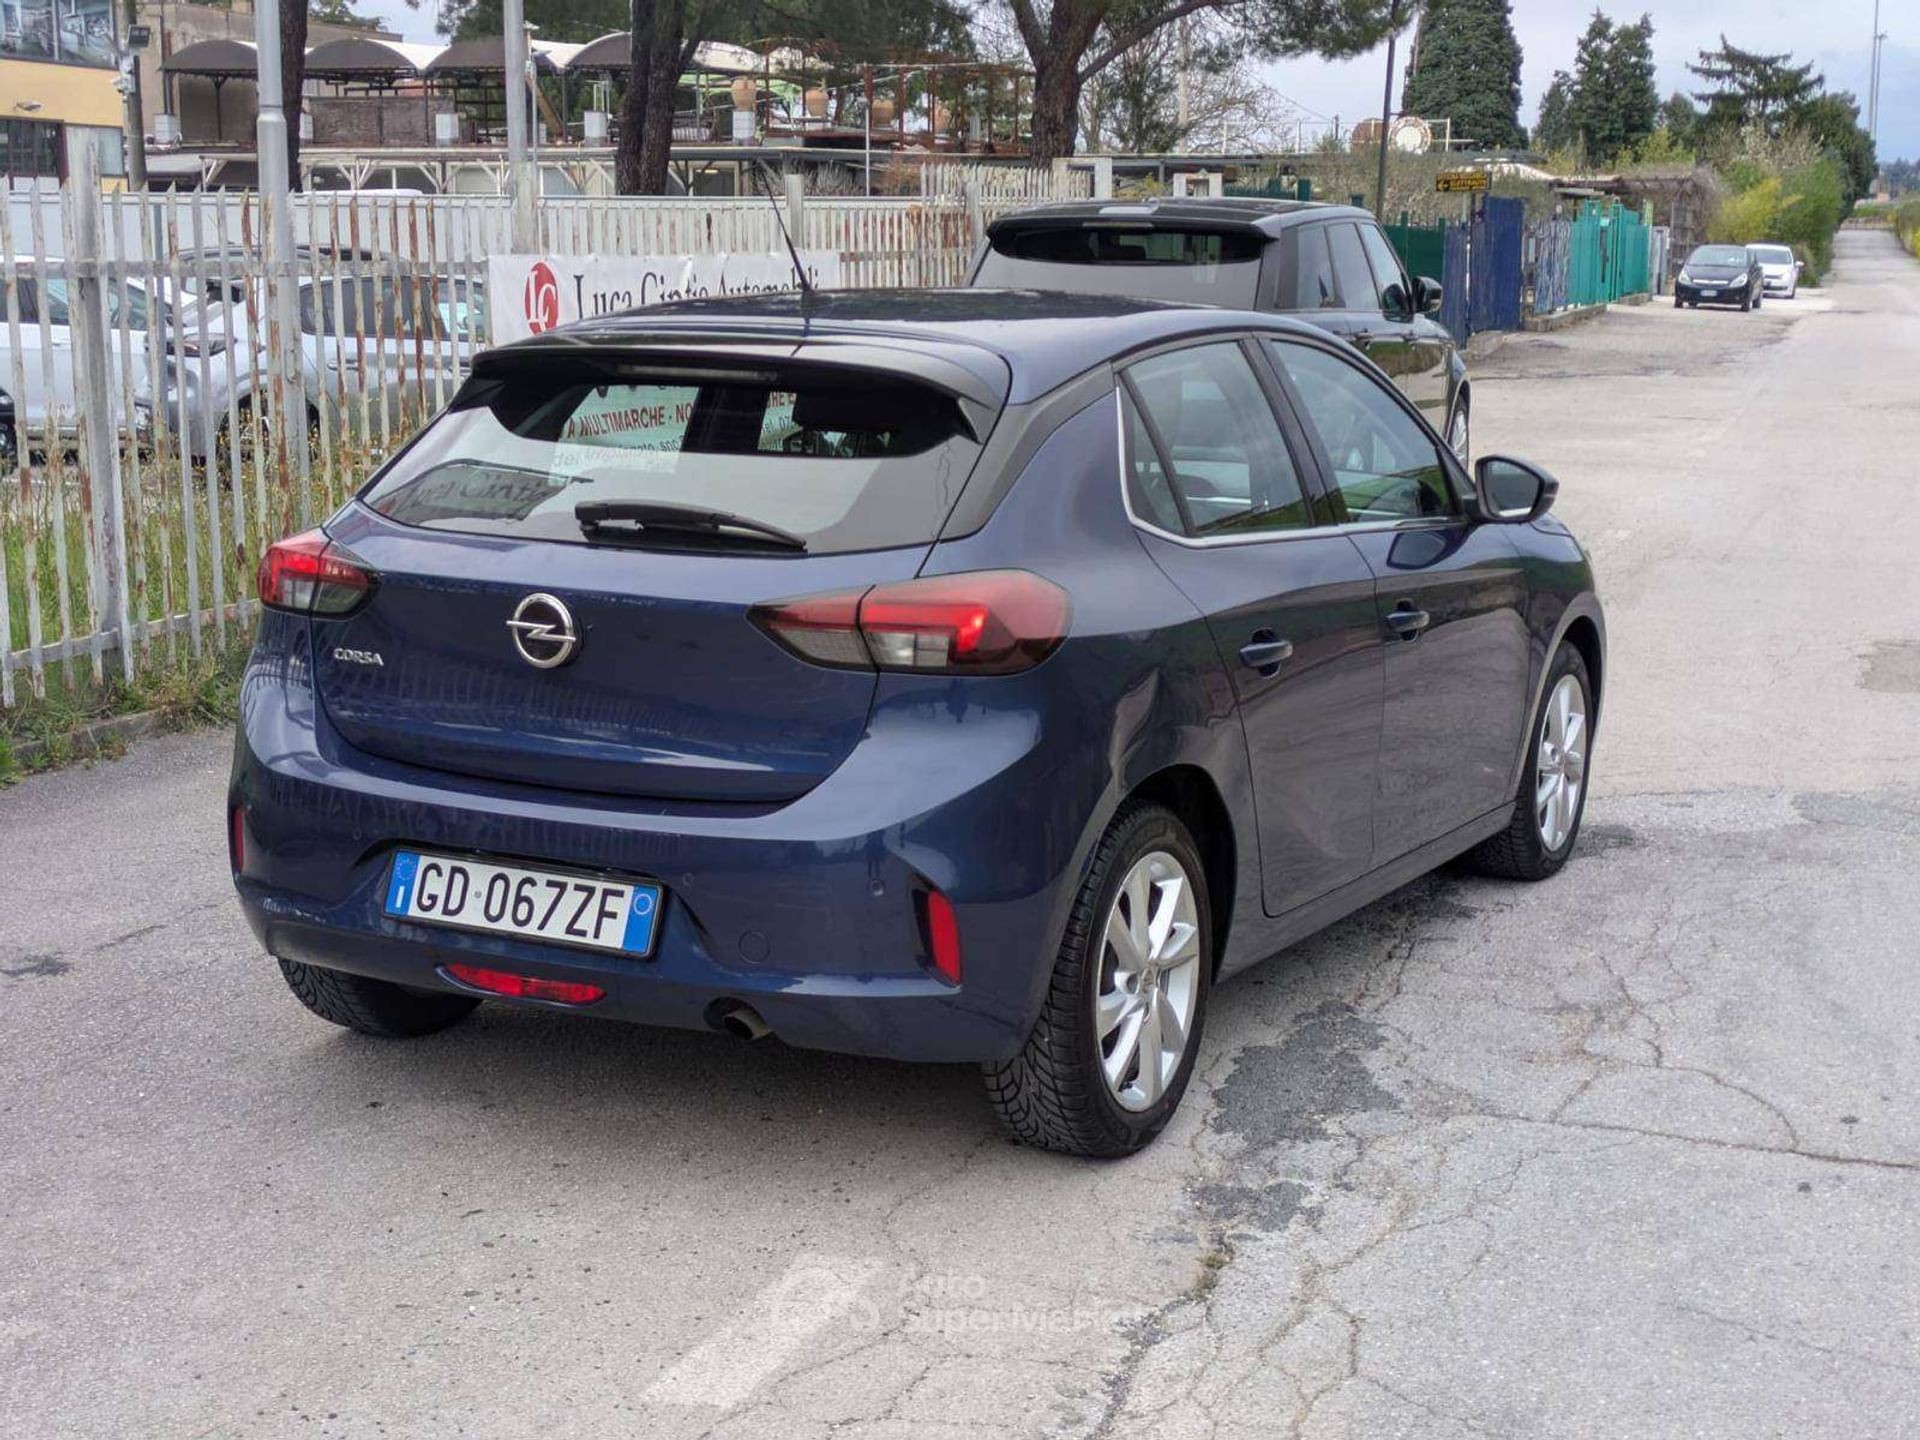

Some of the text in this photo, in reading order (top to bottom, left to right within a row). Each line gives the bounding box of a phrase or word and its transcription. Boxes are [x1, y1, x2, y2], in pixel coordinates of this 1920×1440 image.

[573, 274, 632, 320] Luca
[578, 405, 666, 437] MULTIMARCHE
[333, 647, 384, 666] CORSA
[416, 862, 470, 917] GD
[483, 872, 625, 940] 067ZF
